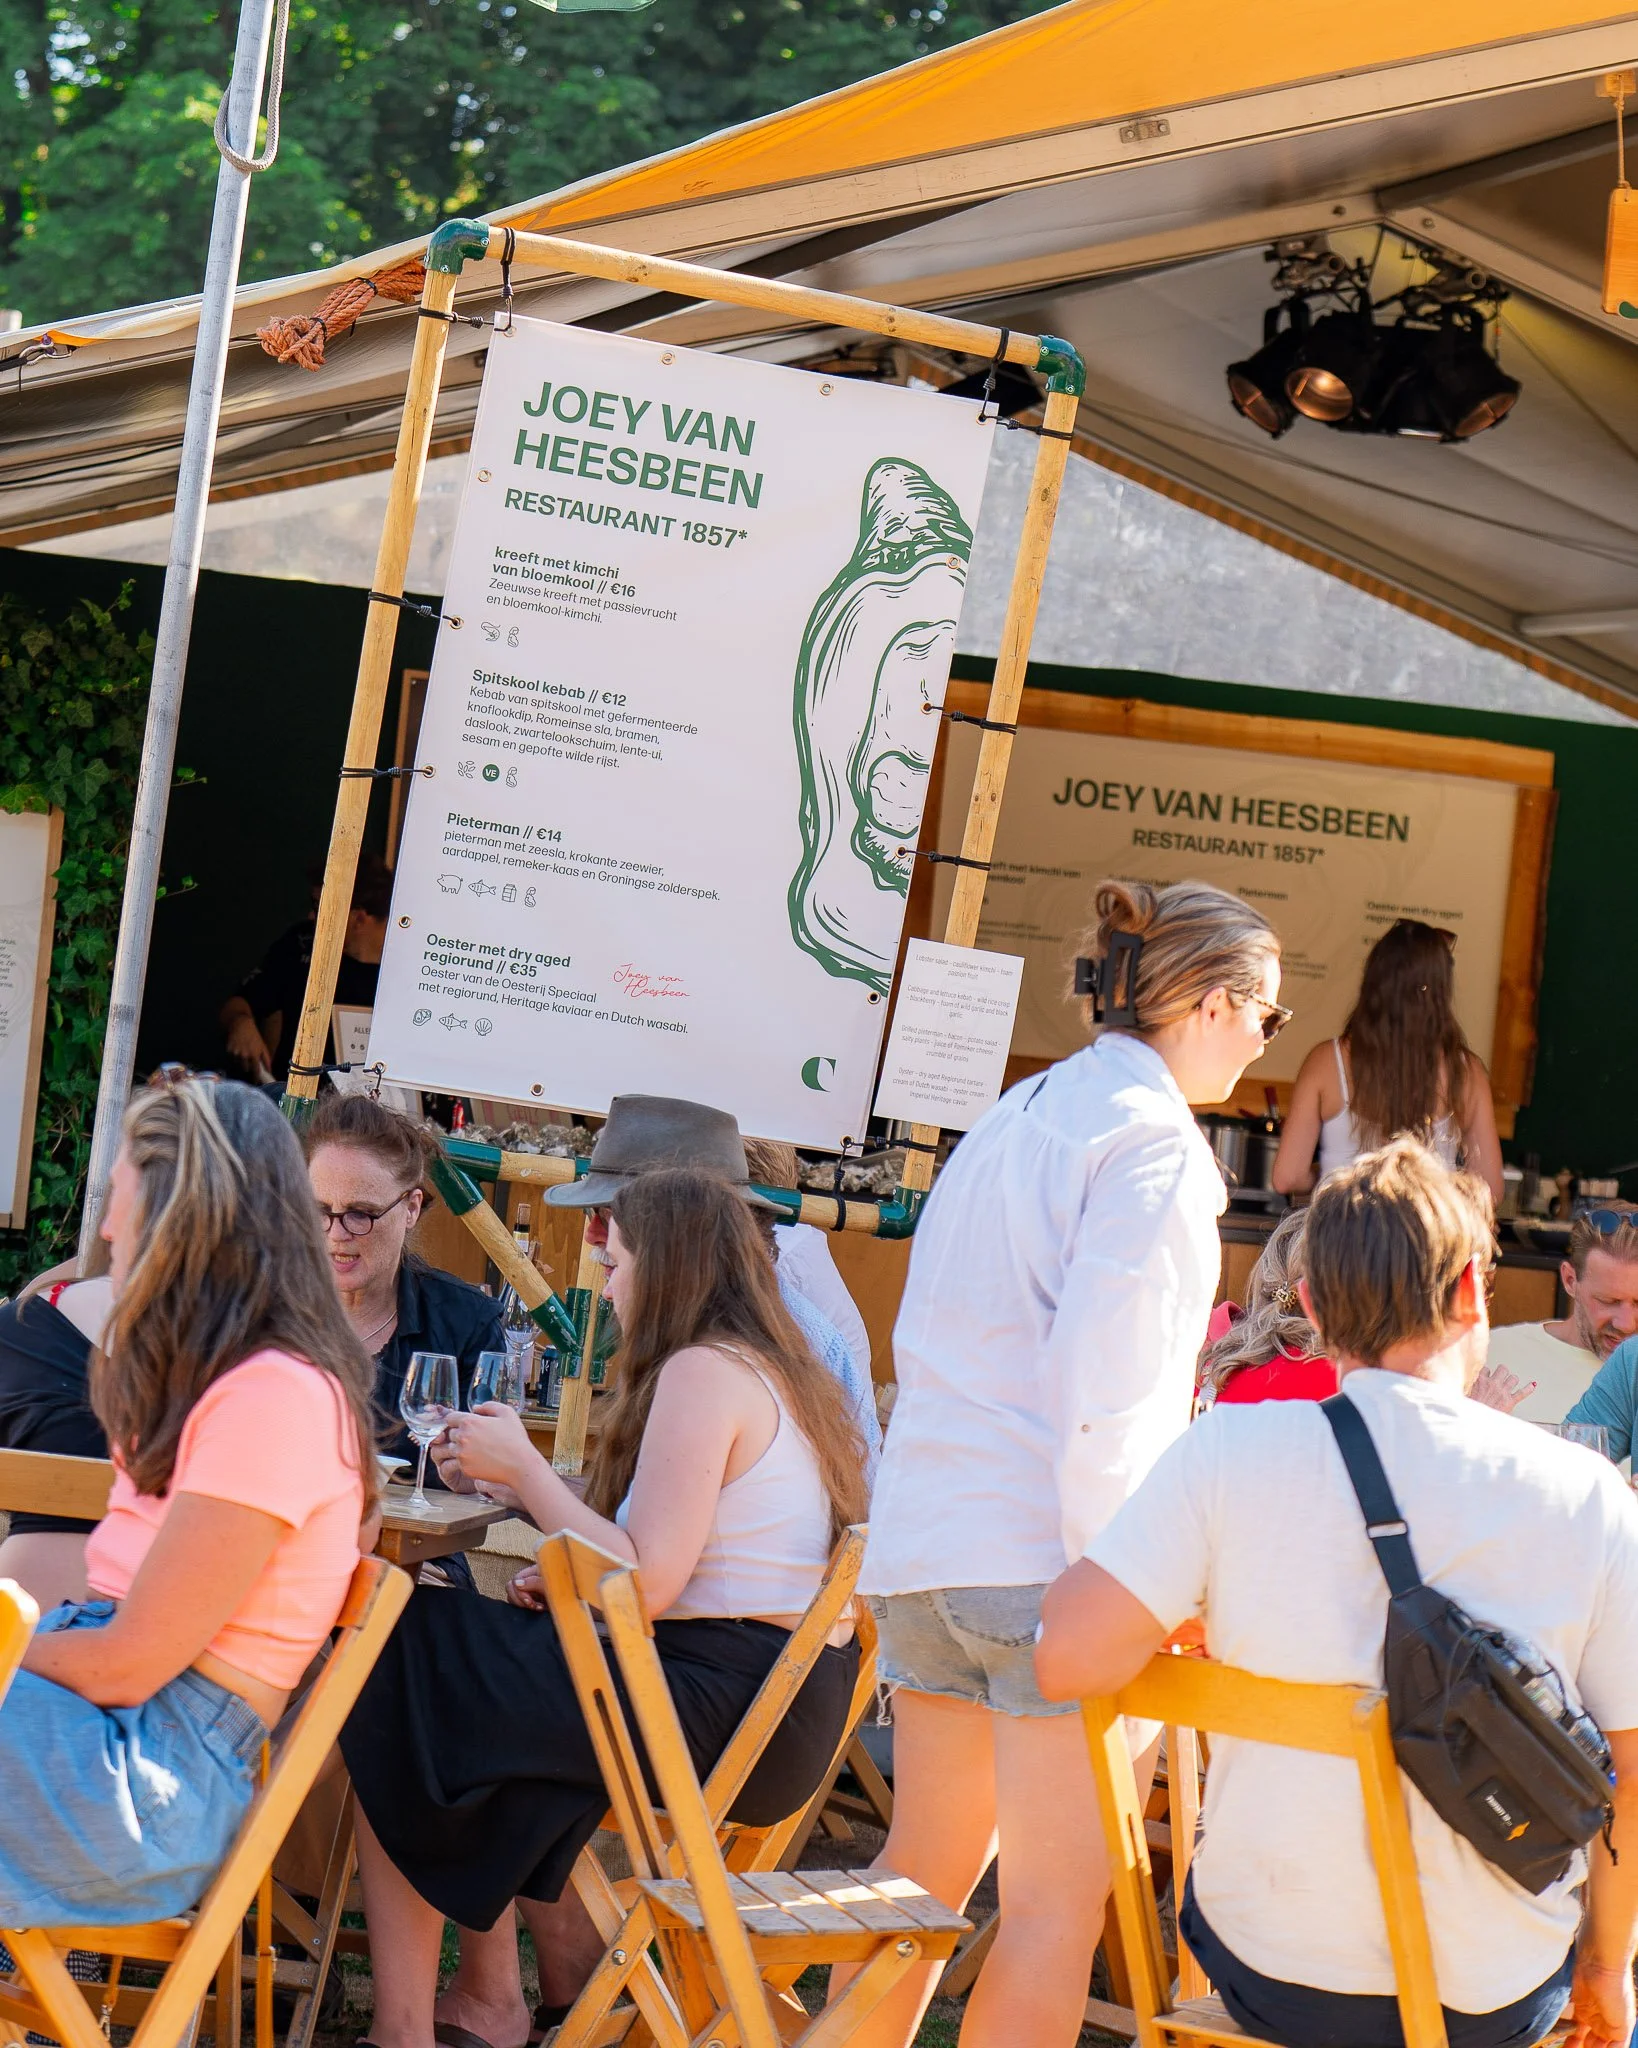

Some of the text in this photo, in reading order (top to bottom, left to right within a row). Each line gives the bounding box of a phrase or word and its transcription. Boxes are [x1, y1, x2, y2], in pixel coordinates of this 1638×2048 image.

[523, 382, 756, 456] JOEY VAN
[513, 429, 764, 509] HEESBEEN
[504, 488, 677, 538] RESTAURANT
[493, 564, 518, 577] van
[521, 566, 595, 591] bloemkool
[610, 583, 636, 598] €16
[495, 546, 620, 579] kreeft met kimchi
[486, 595, 602, 624] en bloemkool-kimchi.
[489, 578, 677, 621] Zeeuwse kreeft met passievrucht
[472, 669, 540, 692] Spitskool
[542, 681, 585, 700] kebab
[602, 692, 627, 707] €12
[467, 701, 660, 745] knoflookdip, Romeinse sla, bramen,
[470, 685, 698, 735] Kebab van spitskool met gefermenteerde
[462, 733, 620, 768] sesam en gepofte wilde rijst.
[464, 717, 663, 761] daslook, zwartelookschuim, lente-ui,
[485, 768, 497, 778] VE
[447, 812, 520, 836] Pieterman
[536, 828, 562, 843] €14
[1053, 778, 1410, 842] JOEY VAN HEESBEEN
[444, 830, 664, 877] pieterman met zeesla, krokante zeewier,
[1132, 828, 1268, 859] RESTAURANT
[442, 847, 720, 901] aardappel, remeker-kaas en Groningse zolderspek.
[424, 951, 494, 971] regiorund
[509, 963, 537, 978] €35
[427, 934, 571, 968] Oester met dry aged
[421, 965, 597, 1003] Oester van de Oesterij Speciaal
[418, 983, 688, 1034] met regiorund, Heritage kaviaar en Dutch wasabi.
